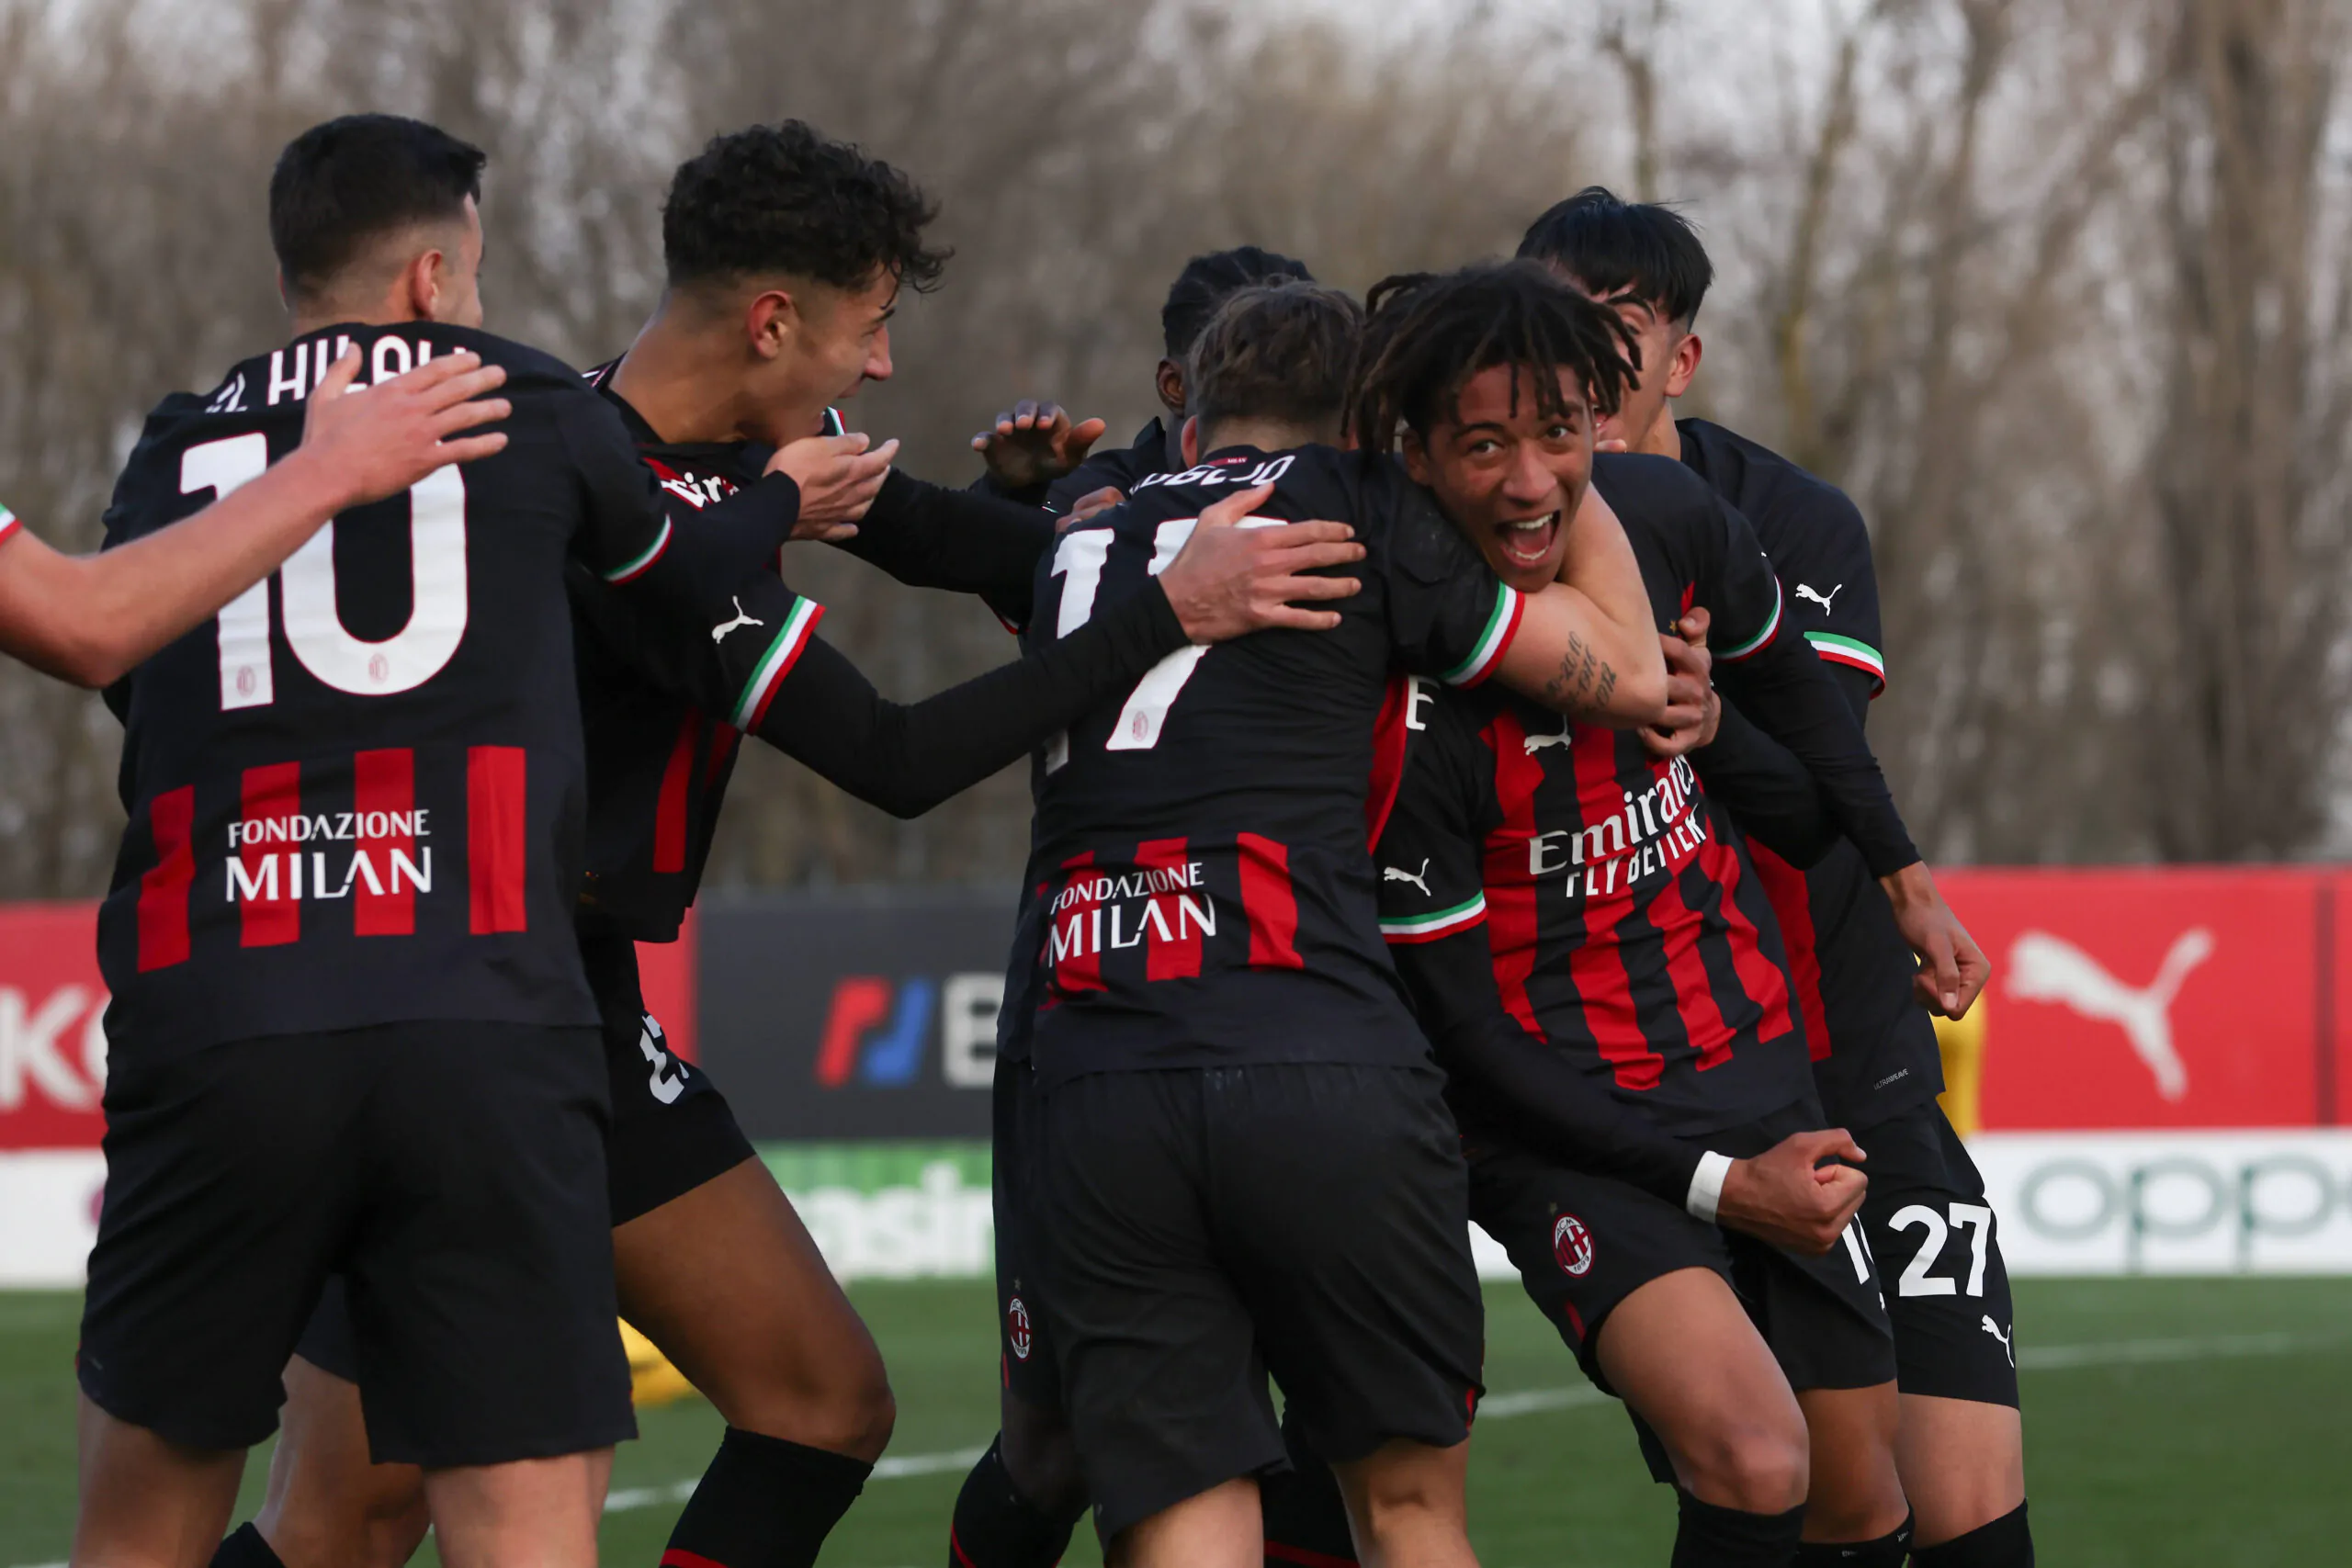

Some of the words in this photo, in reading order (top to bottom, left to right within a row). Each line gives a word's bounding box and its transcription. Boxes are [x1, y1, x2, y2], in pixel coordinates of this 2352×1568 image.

[180, 432, 469, 711] 10
[228, 809, 431, 848] FONDAZIONE
[225, 846, 432, 902] MILAN
[1050, 862, 1204, 915] FONDAZIONE
[1048, 893, 1216, 967] MILAN
[1888, 1201, 1992, 1297] 27
